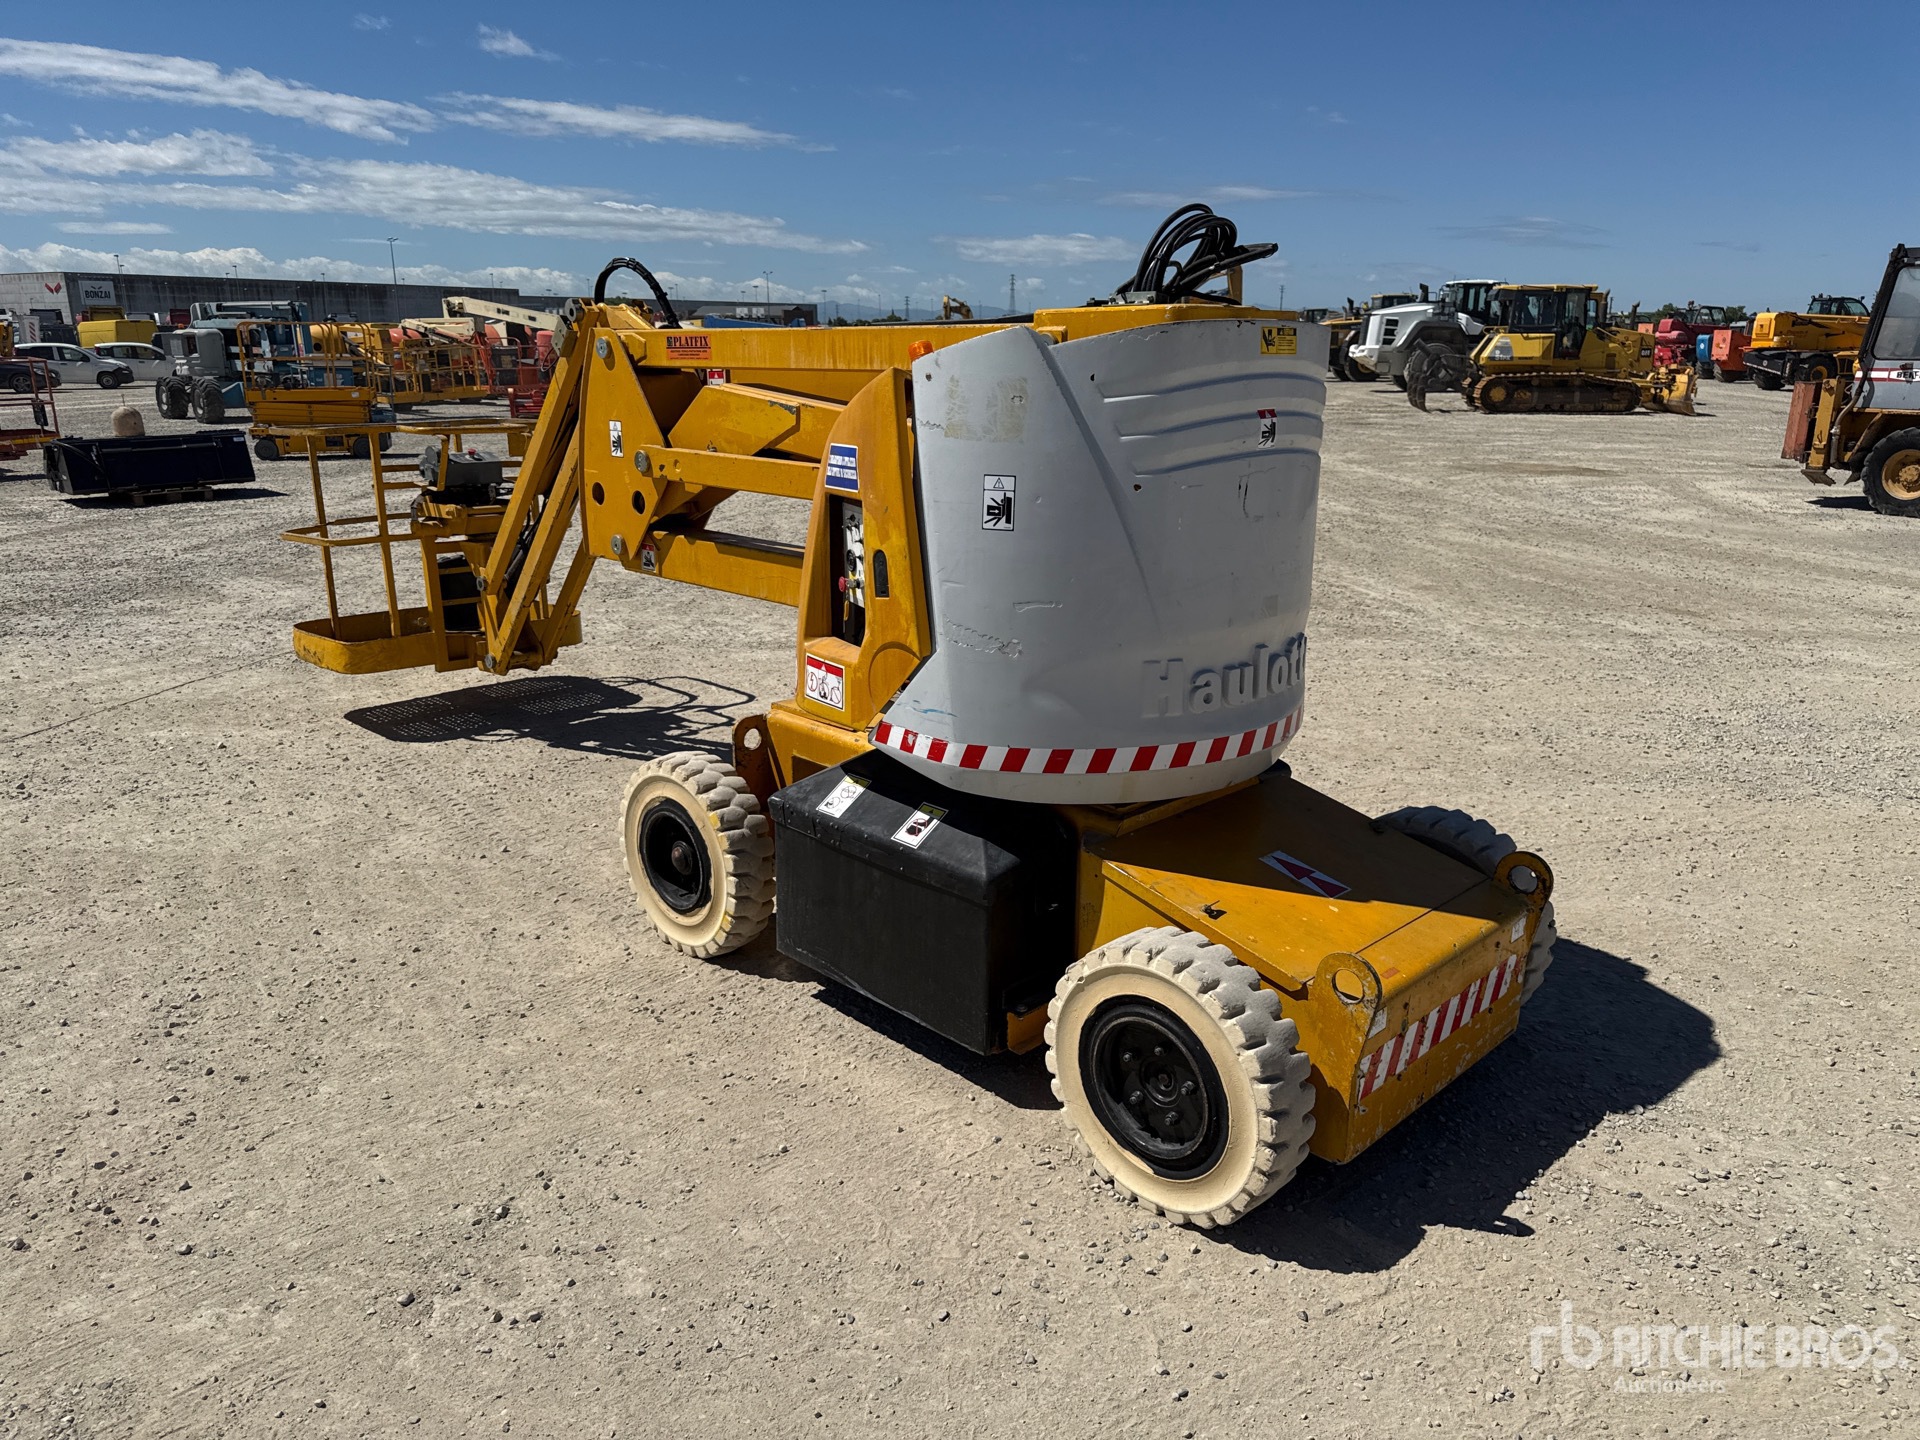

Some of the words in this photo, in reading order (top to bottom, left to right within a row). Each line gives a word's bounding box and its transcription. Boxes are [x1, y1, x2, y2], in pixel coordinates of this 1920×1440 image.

[84, 290, 111, 299] BONZAI
[673, 336, 709, 347] PLATFIX
[1896, 371, 1920, 379] BENF
